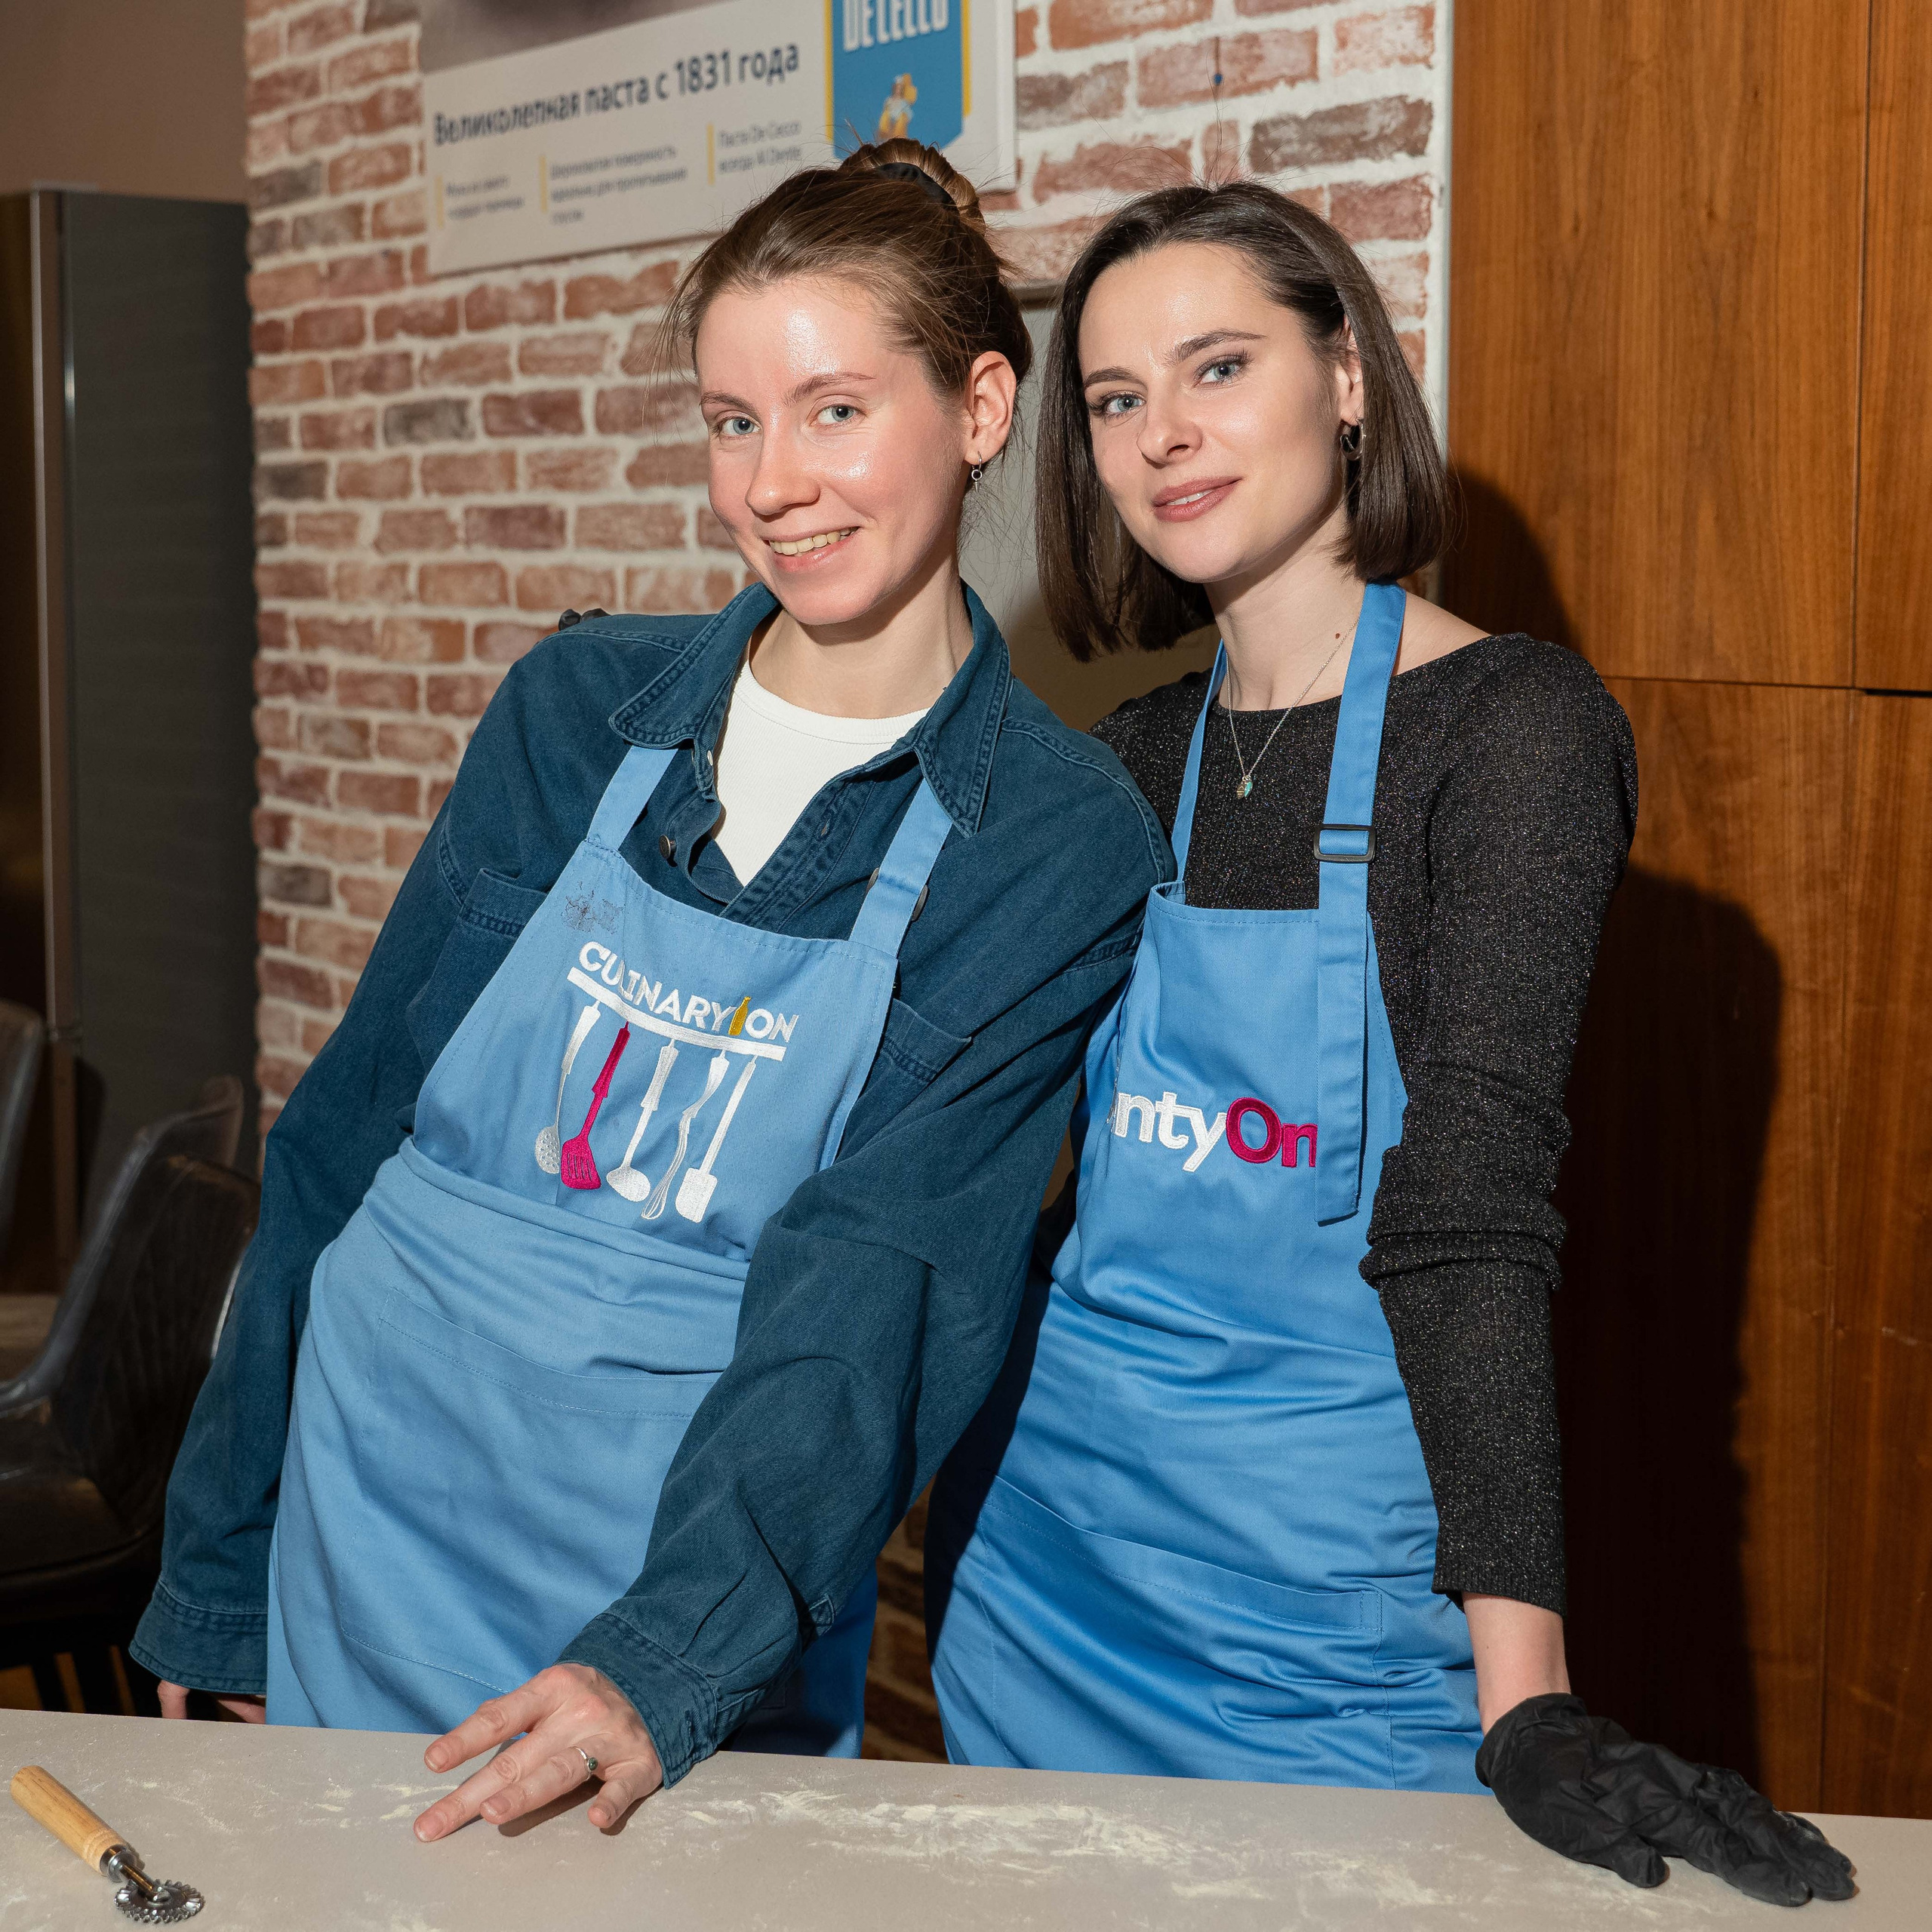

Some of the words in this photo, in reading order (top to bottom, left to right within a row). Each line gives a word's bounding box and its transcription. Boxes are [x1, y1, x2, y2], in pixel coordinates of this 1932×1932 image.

[434, 91, 580, 146] Великолепная
[583, 75, 650, 115] паста
[655, 72, 669, 100] с
[674, 48, 730, 97] 1831
[738, 42, 799, 86] года
[1110, 1091, 1318, 1172] ntyOn
